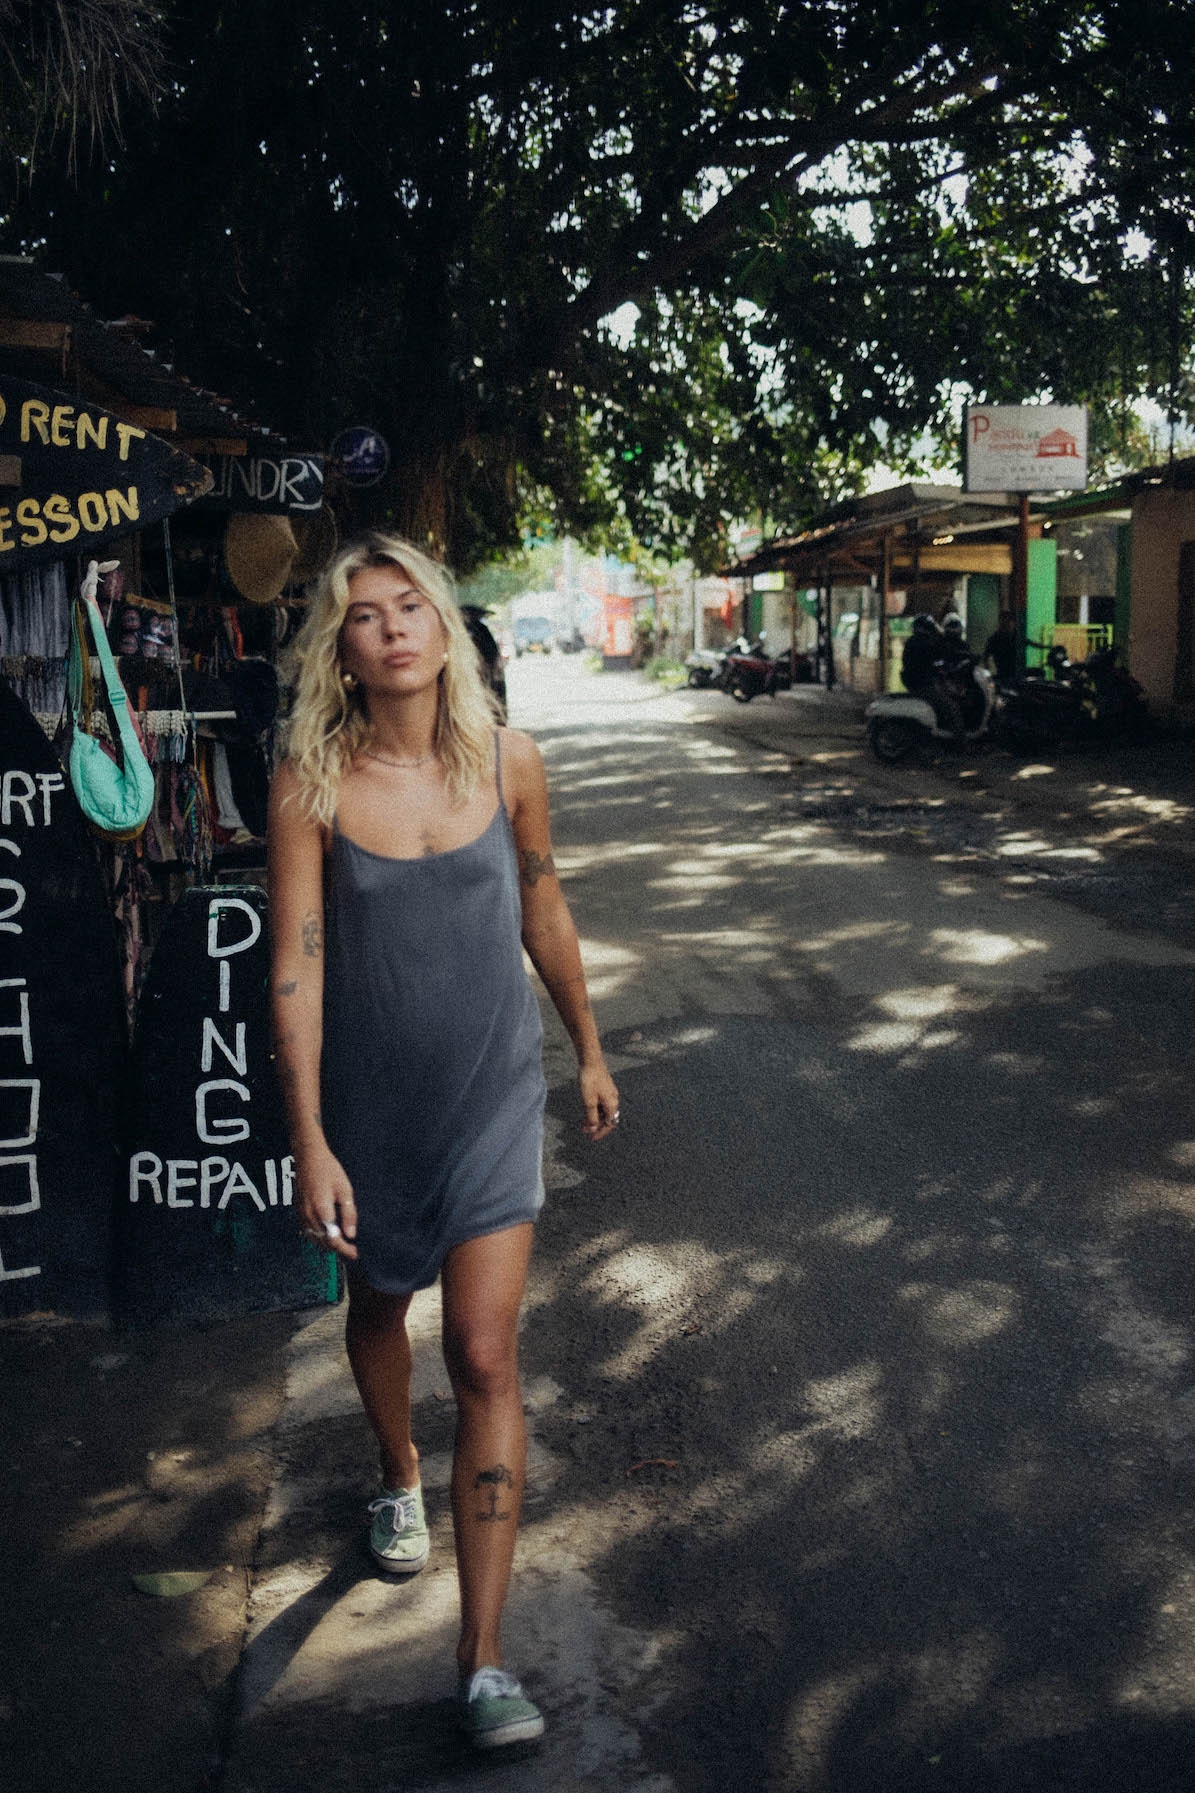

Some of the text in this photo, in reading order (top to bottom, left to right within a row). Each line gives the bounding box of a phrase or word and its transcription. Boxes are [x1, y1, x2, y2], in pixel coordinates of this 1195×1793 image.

[20, 398, 146, 462] RENT
[0, 769, 65, 827] RF
[195, 897, 262, 1146] DING
